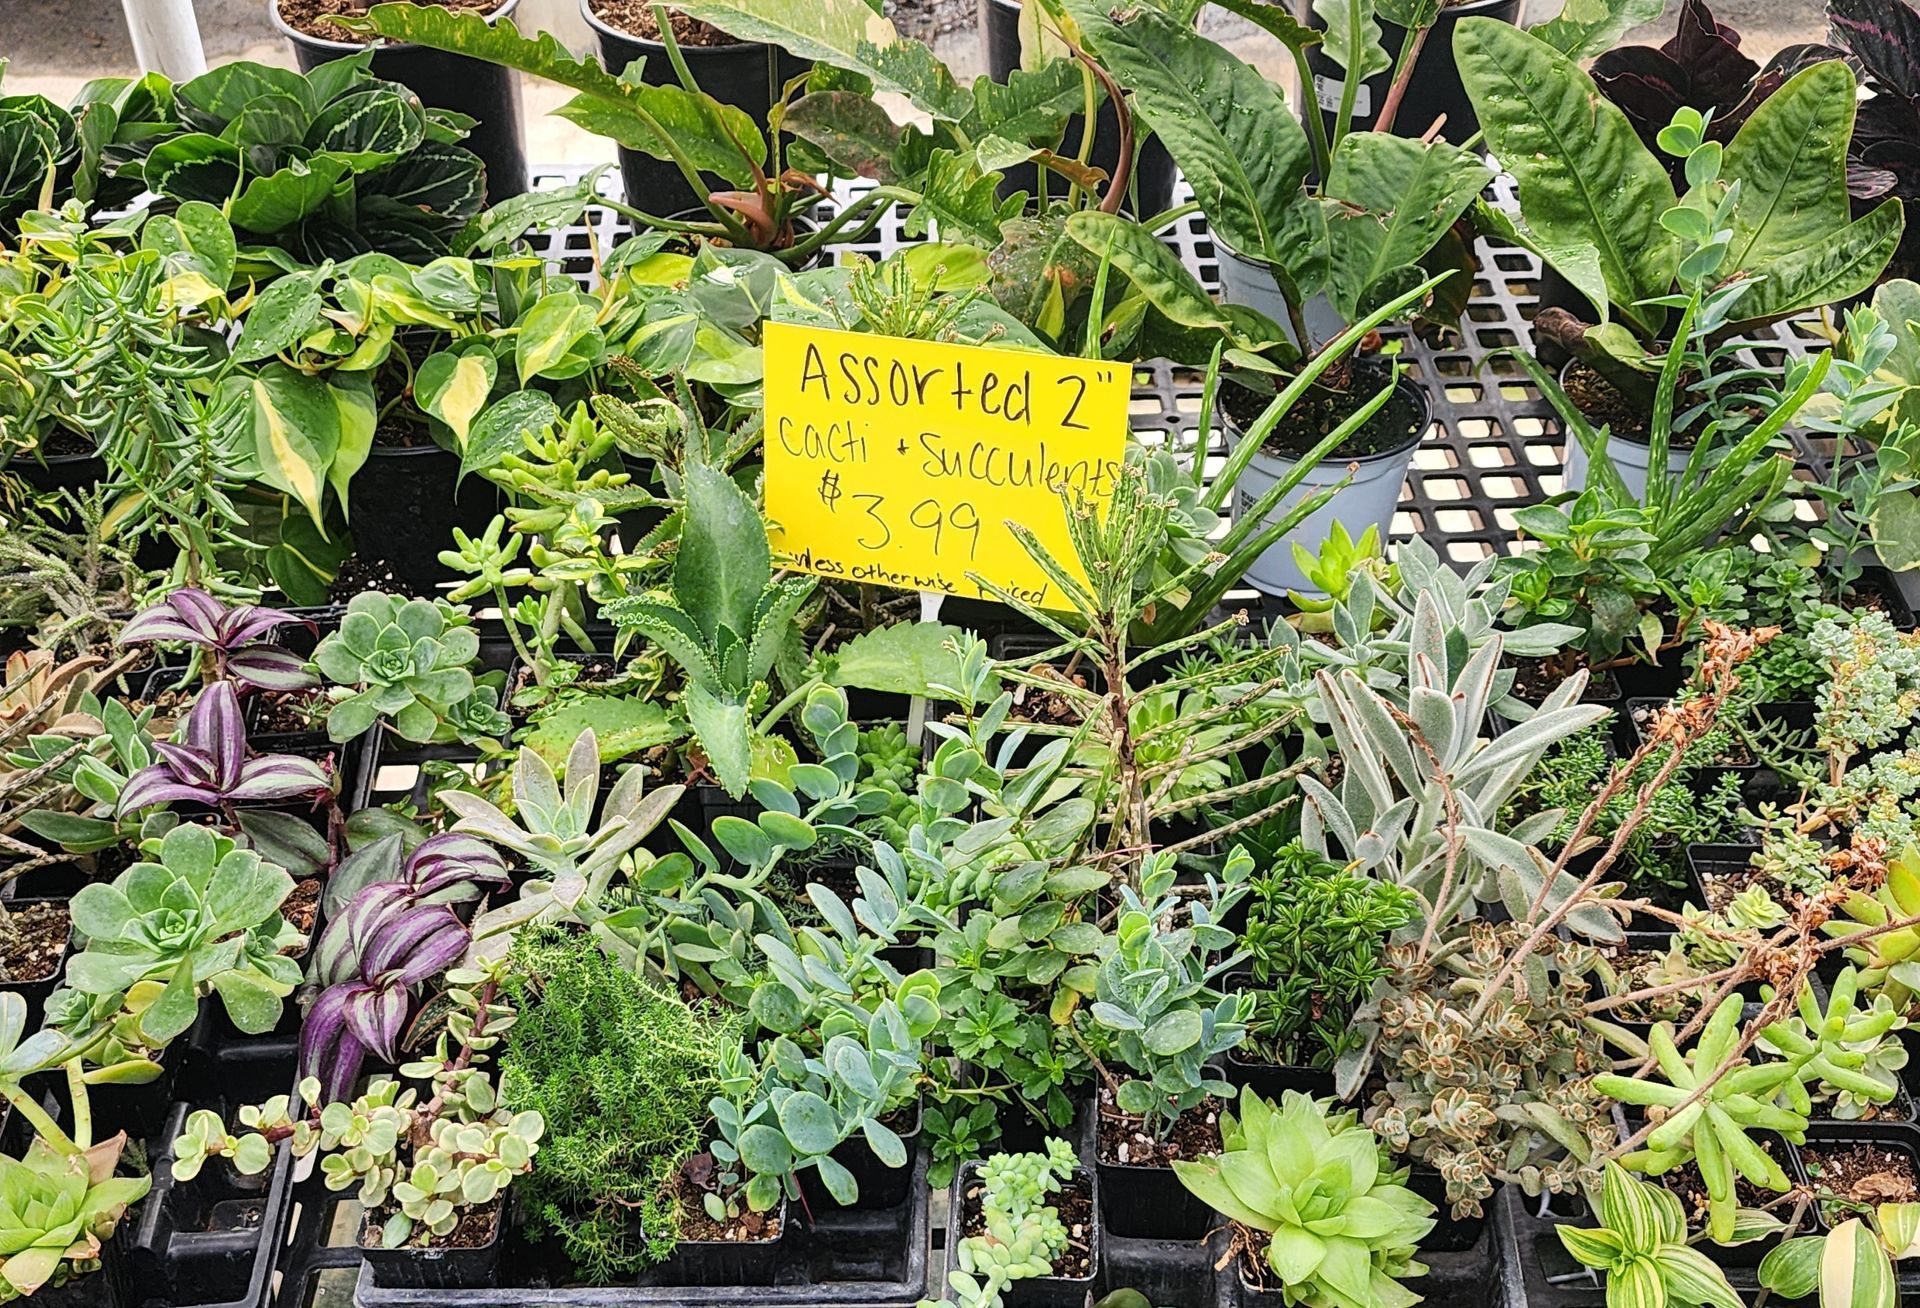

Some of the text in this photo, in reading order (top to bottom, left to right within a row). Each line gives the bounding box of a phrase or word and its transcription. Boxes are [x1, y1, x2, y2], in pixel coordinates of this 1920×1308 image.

[800, 342, 1113, 430] Assorted 2"
[977, 580, 1048, 606] iced
